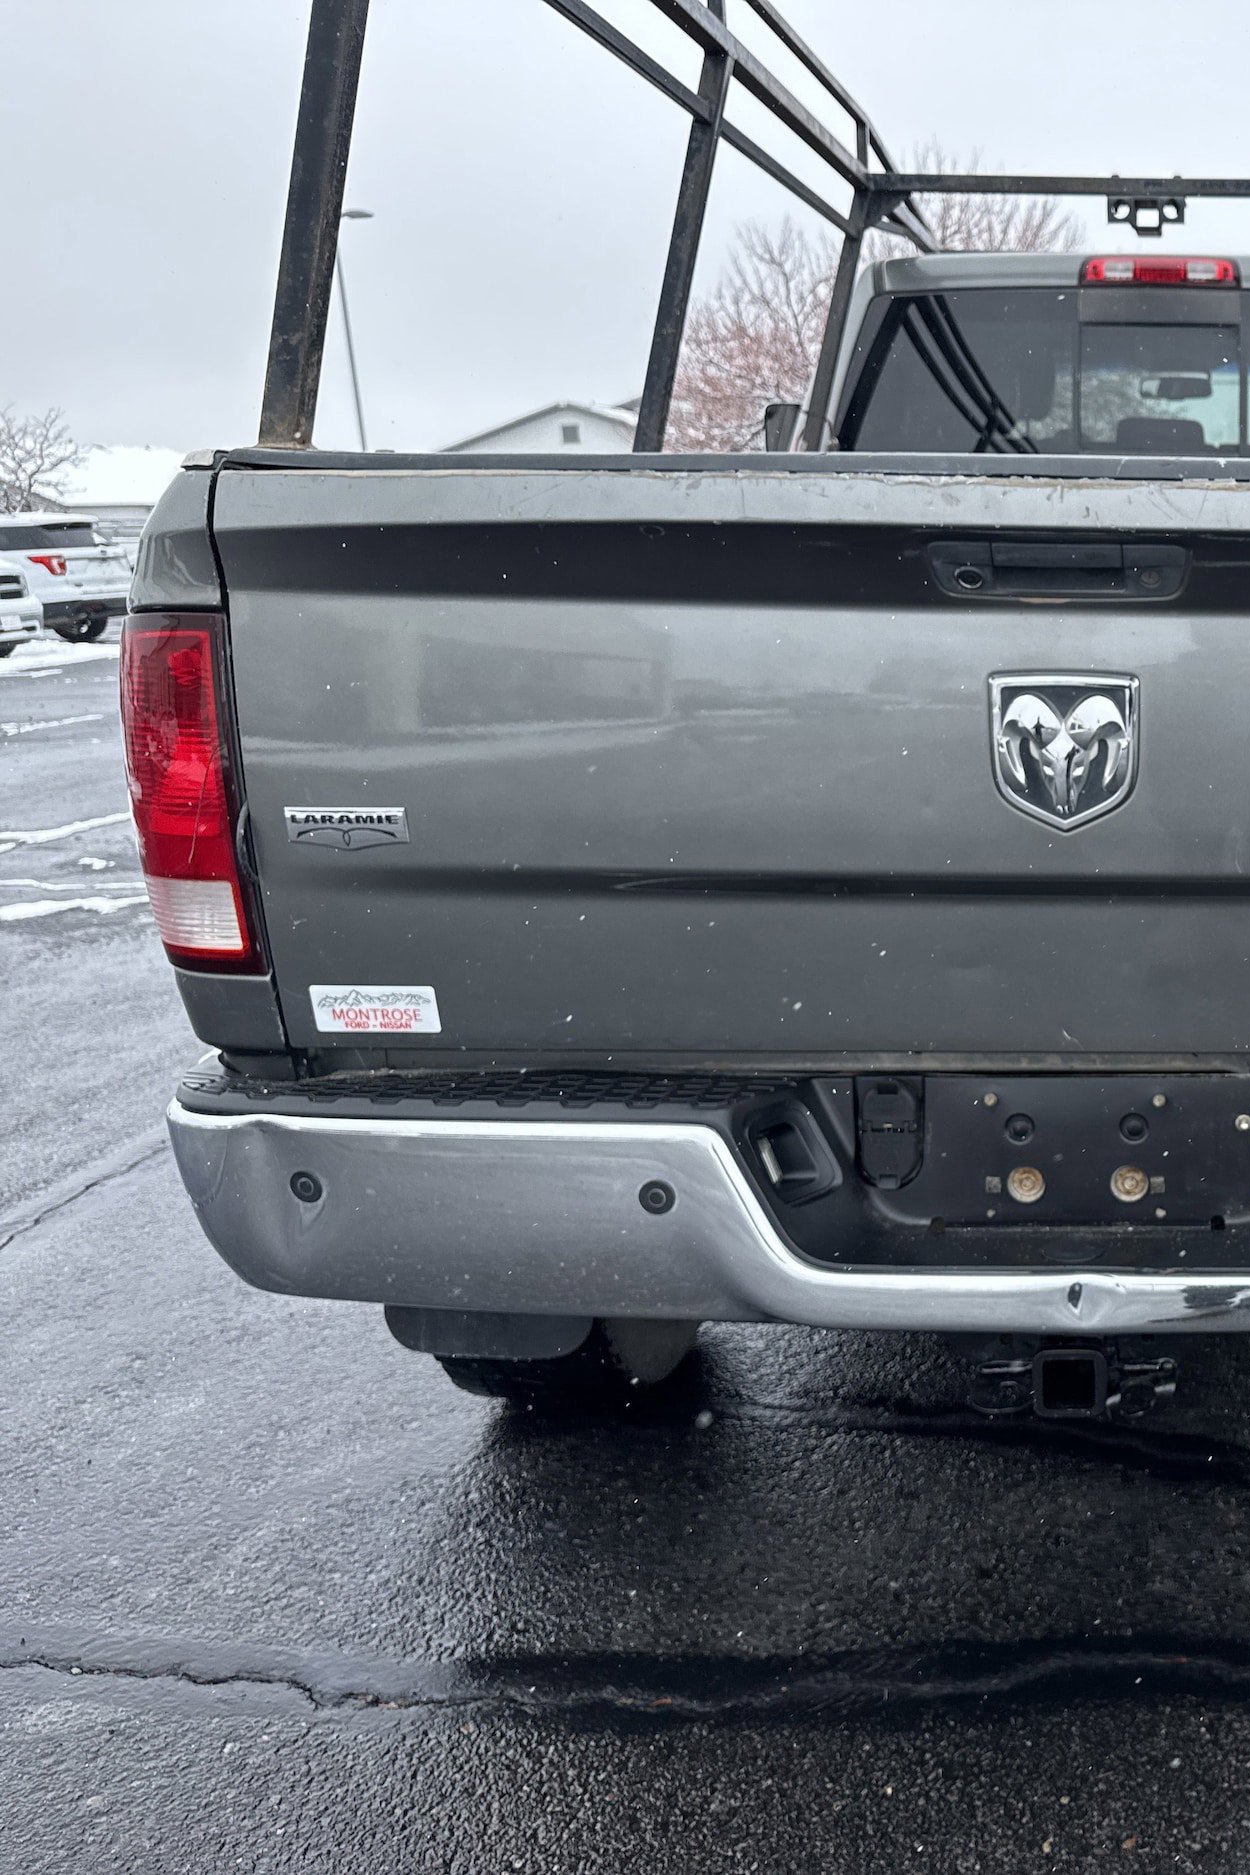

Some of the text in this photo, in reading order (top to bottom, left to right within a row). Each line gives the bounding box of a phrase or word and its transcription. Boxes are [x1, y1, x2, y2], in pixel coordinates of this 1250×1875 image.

[290, 814, 399, 824] LARAMIE
[331, 1008, 423, 1021] MONTROSE
[345, 1021, 370, 1029] FORD
[379, 1021, 412, 1029] NISSAN
